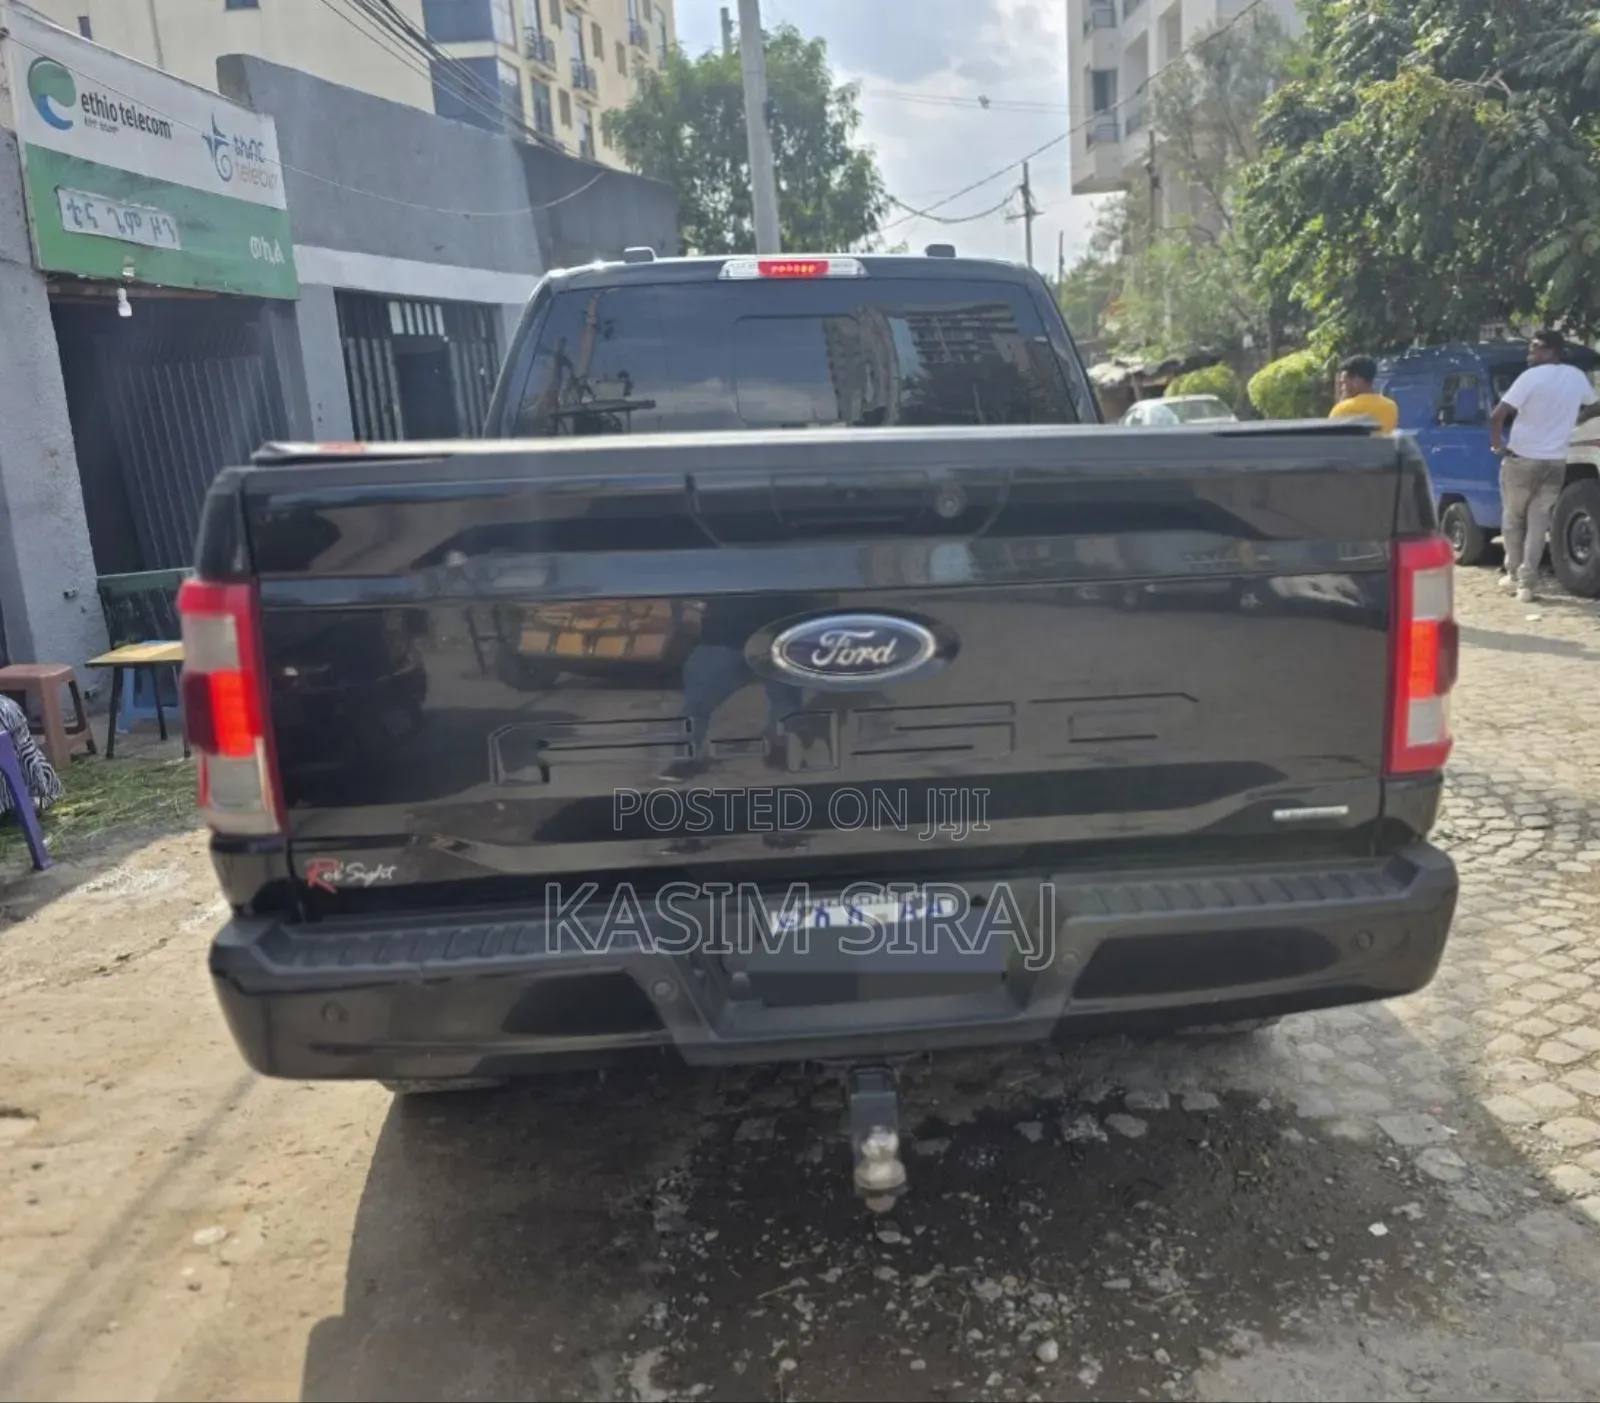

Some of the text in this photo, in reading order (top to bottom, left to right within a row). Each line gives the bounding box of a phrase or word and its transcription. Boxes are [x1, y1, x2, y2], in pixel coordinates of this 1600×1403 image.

[81, 92, 118, 122] ethio
[119, 102, 172, 140] telecom
[811, 630, 898, 666] Ford
